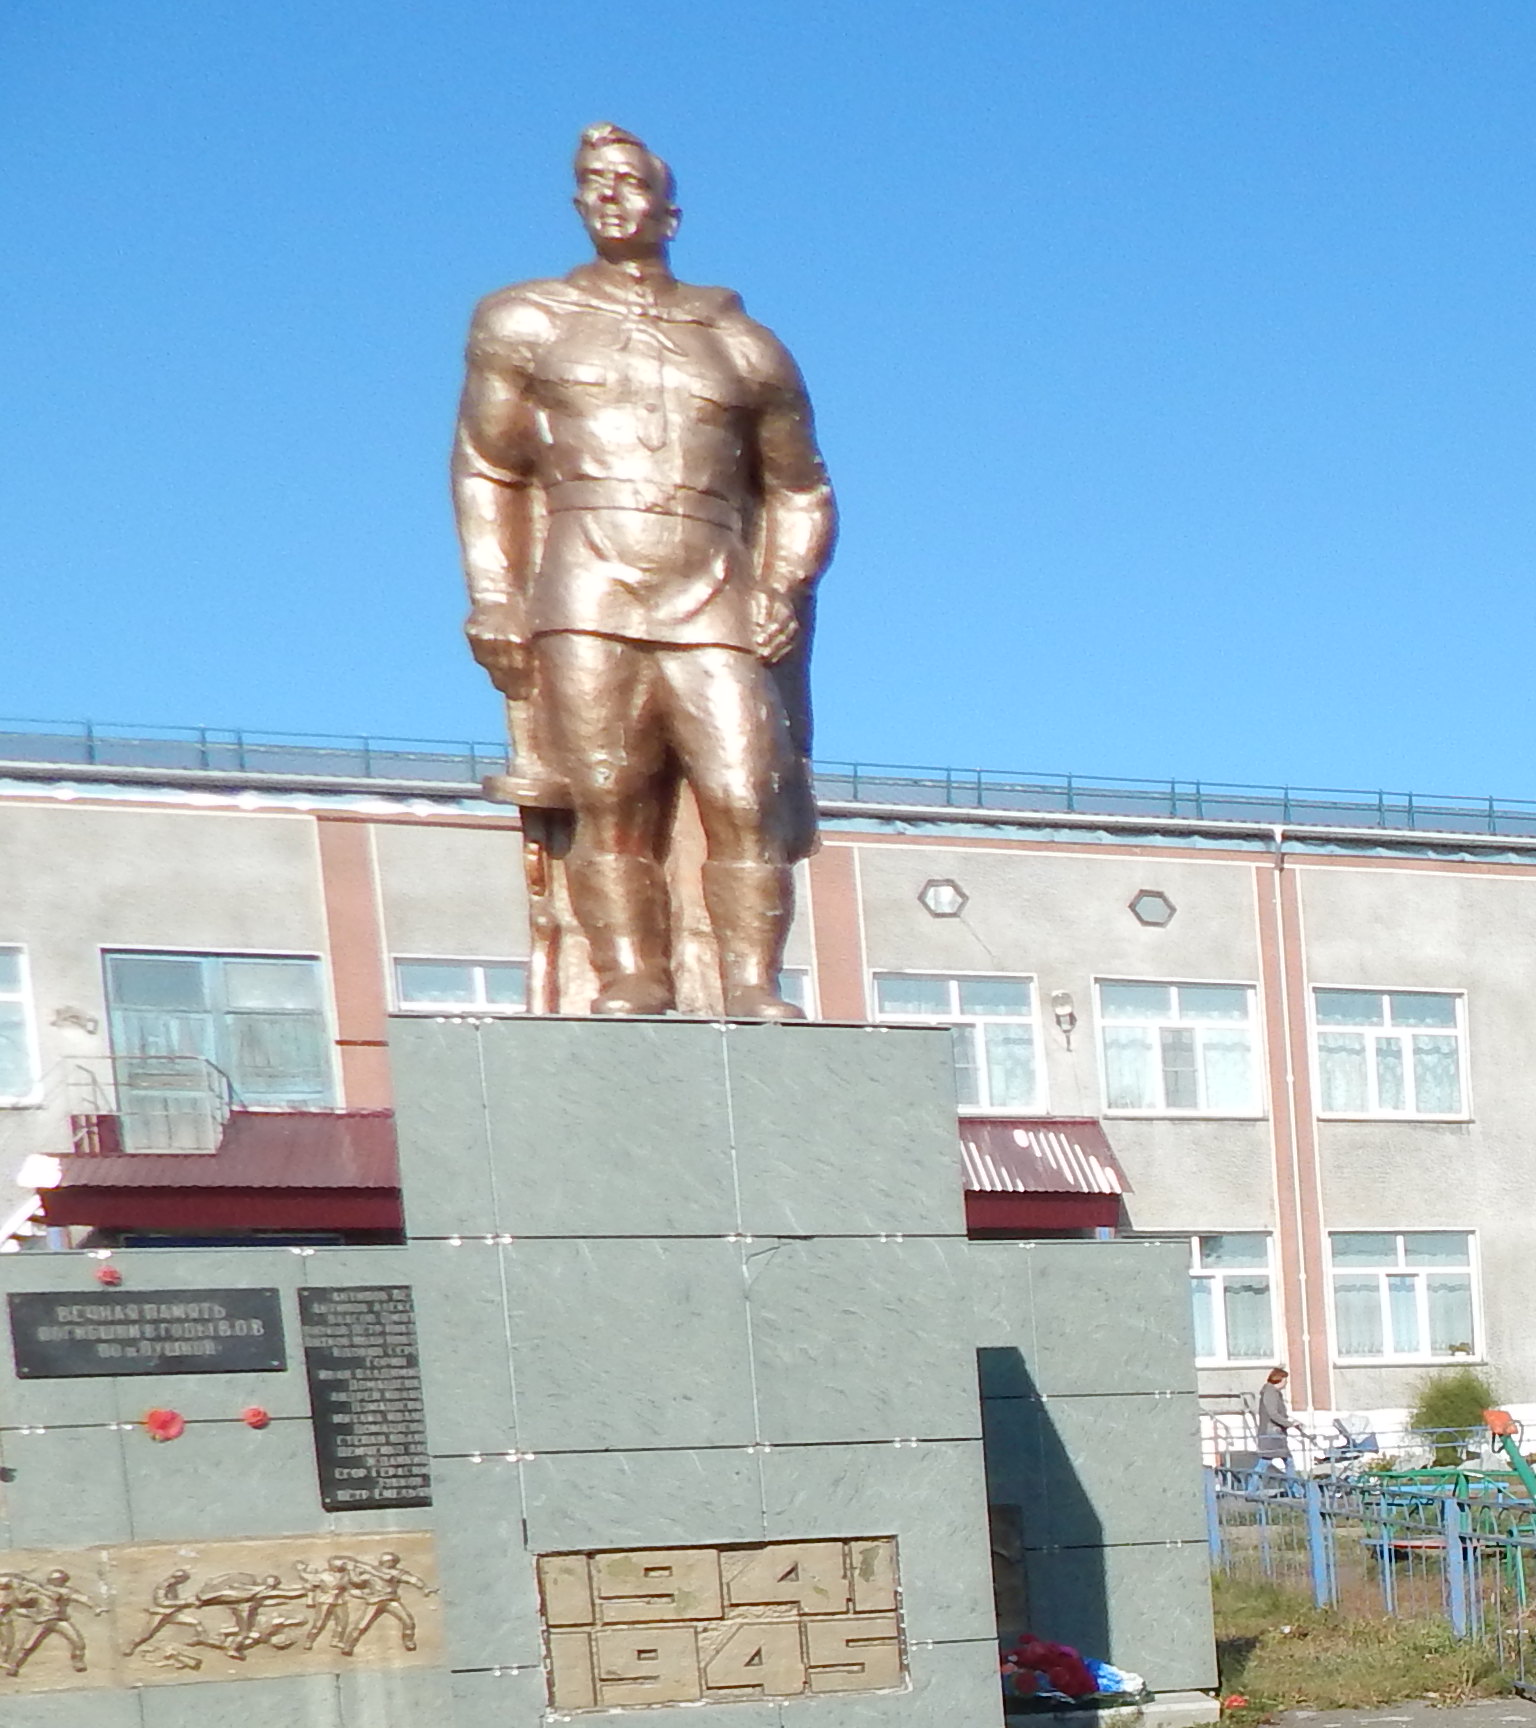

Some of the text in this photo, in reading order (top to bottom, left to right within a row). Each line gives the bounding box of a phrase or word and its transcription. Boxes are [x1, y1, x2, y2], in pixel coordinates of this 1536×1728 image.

[57, 1301, 226, 1322] ВЕЧНАЯ ПАМЯТЬ
[540, 1538, 899, 1627] 1941
[548, 1615, 904, 1709] 1945
